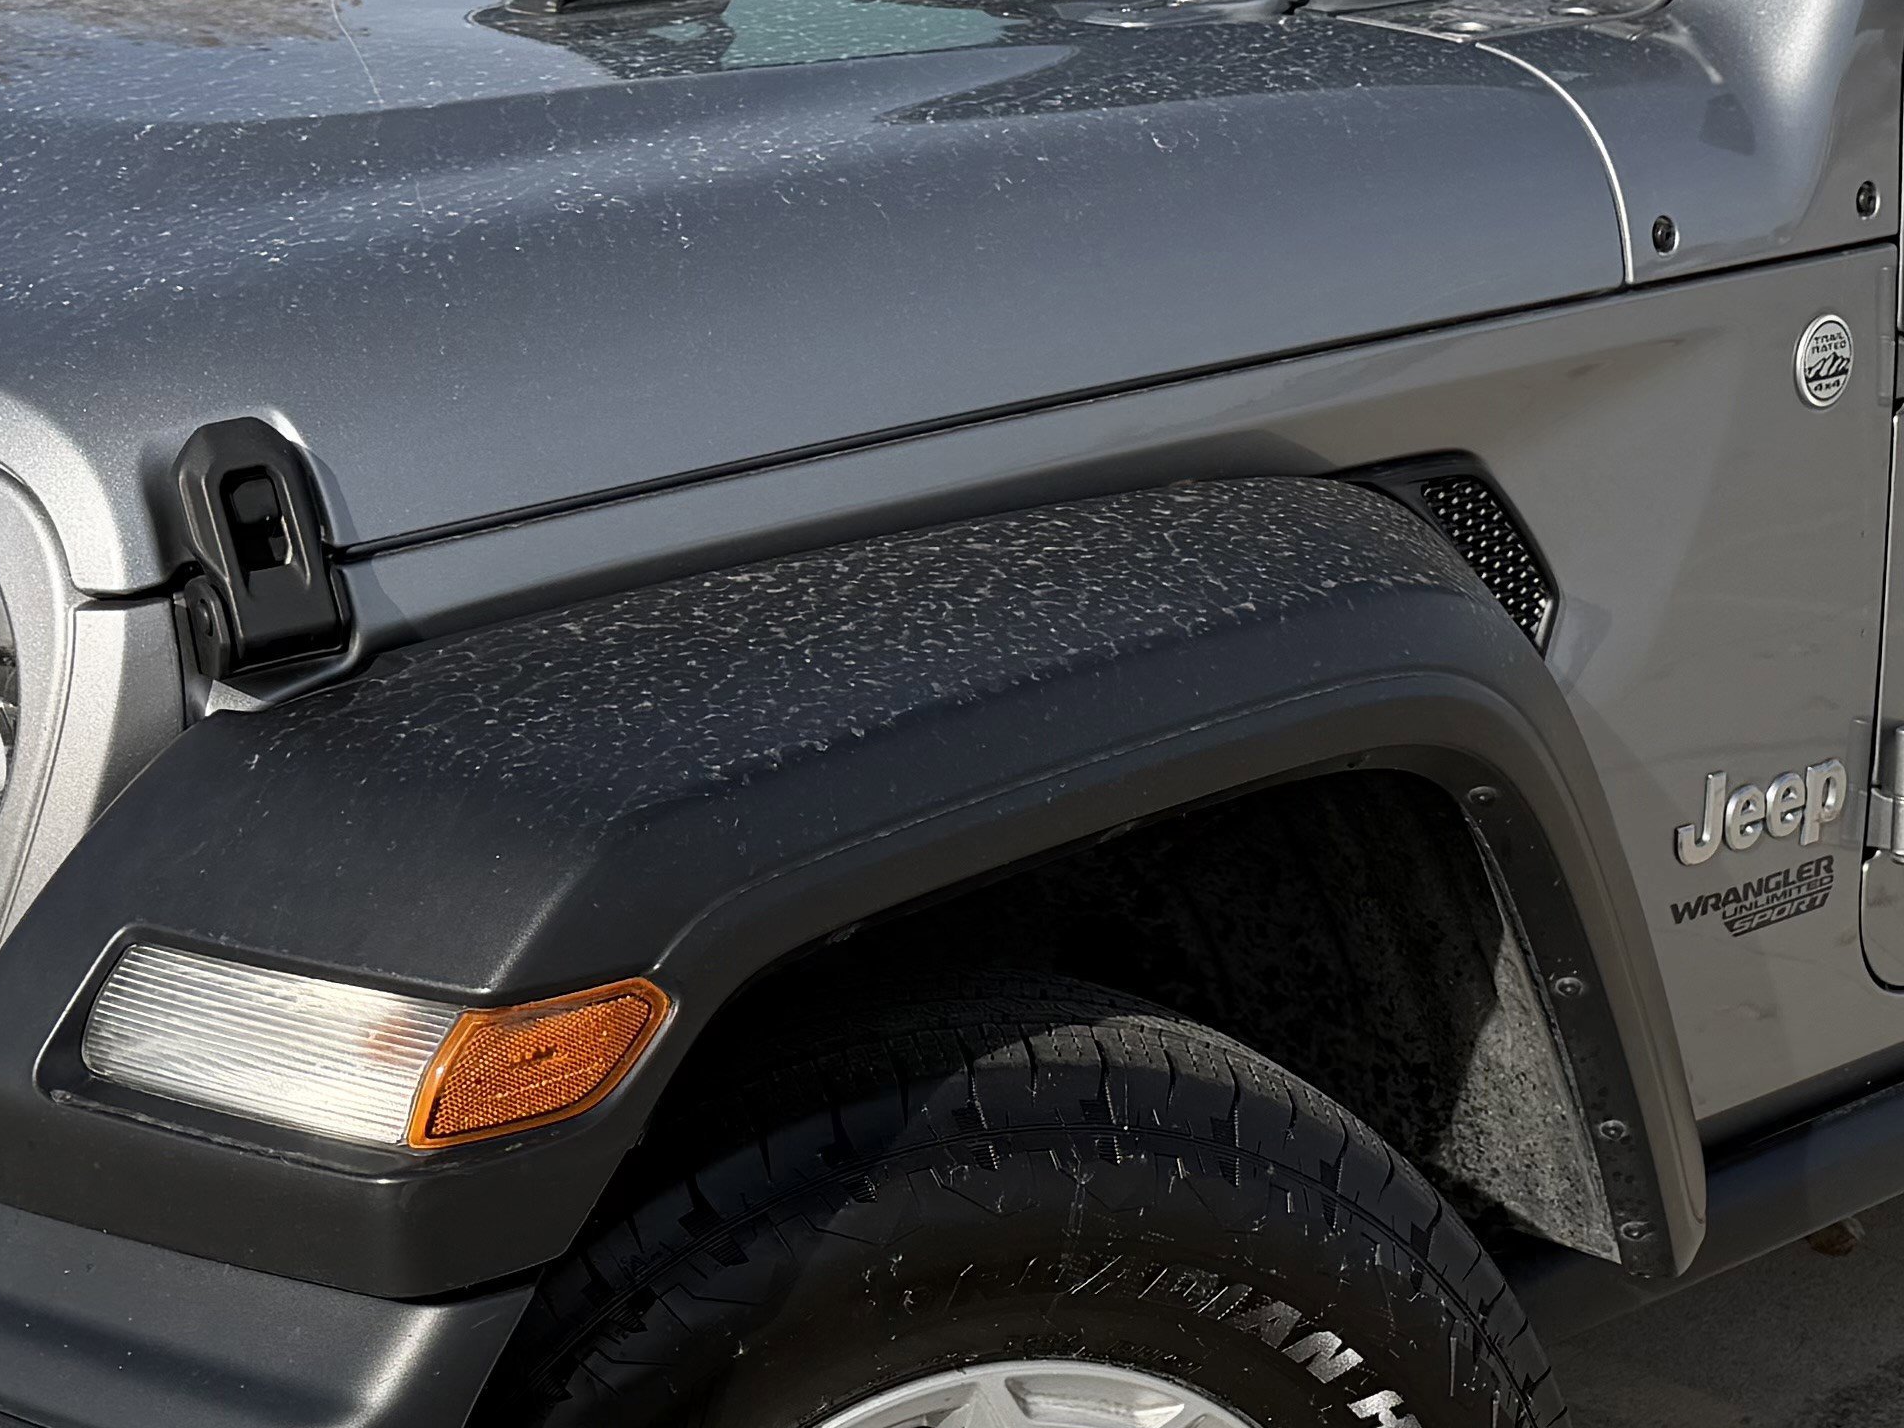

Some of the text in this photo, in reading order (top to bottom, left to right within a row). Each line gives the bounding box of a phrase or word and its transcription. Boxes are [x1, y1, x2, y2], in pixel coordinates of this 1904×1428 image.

[1675, 758, 1847, 866] Jeep
[1670, 854, 1834, 925] WRANGLER
[1721, 874, 1834, 920] UNLIMITED
